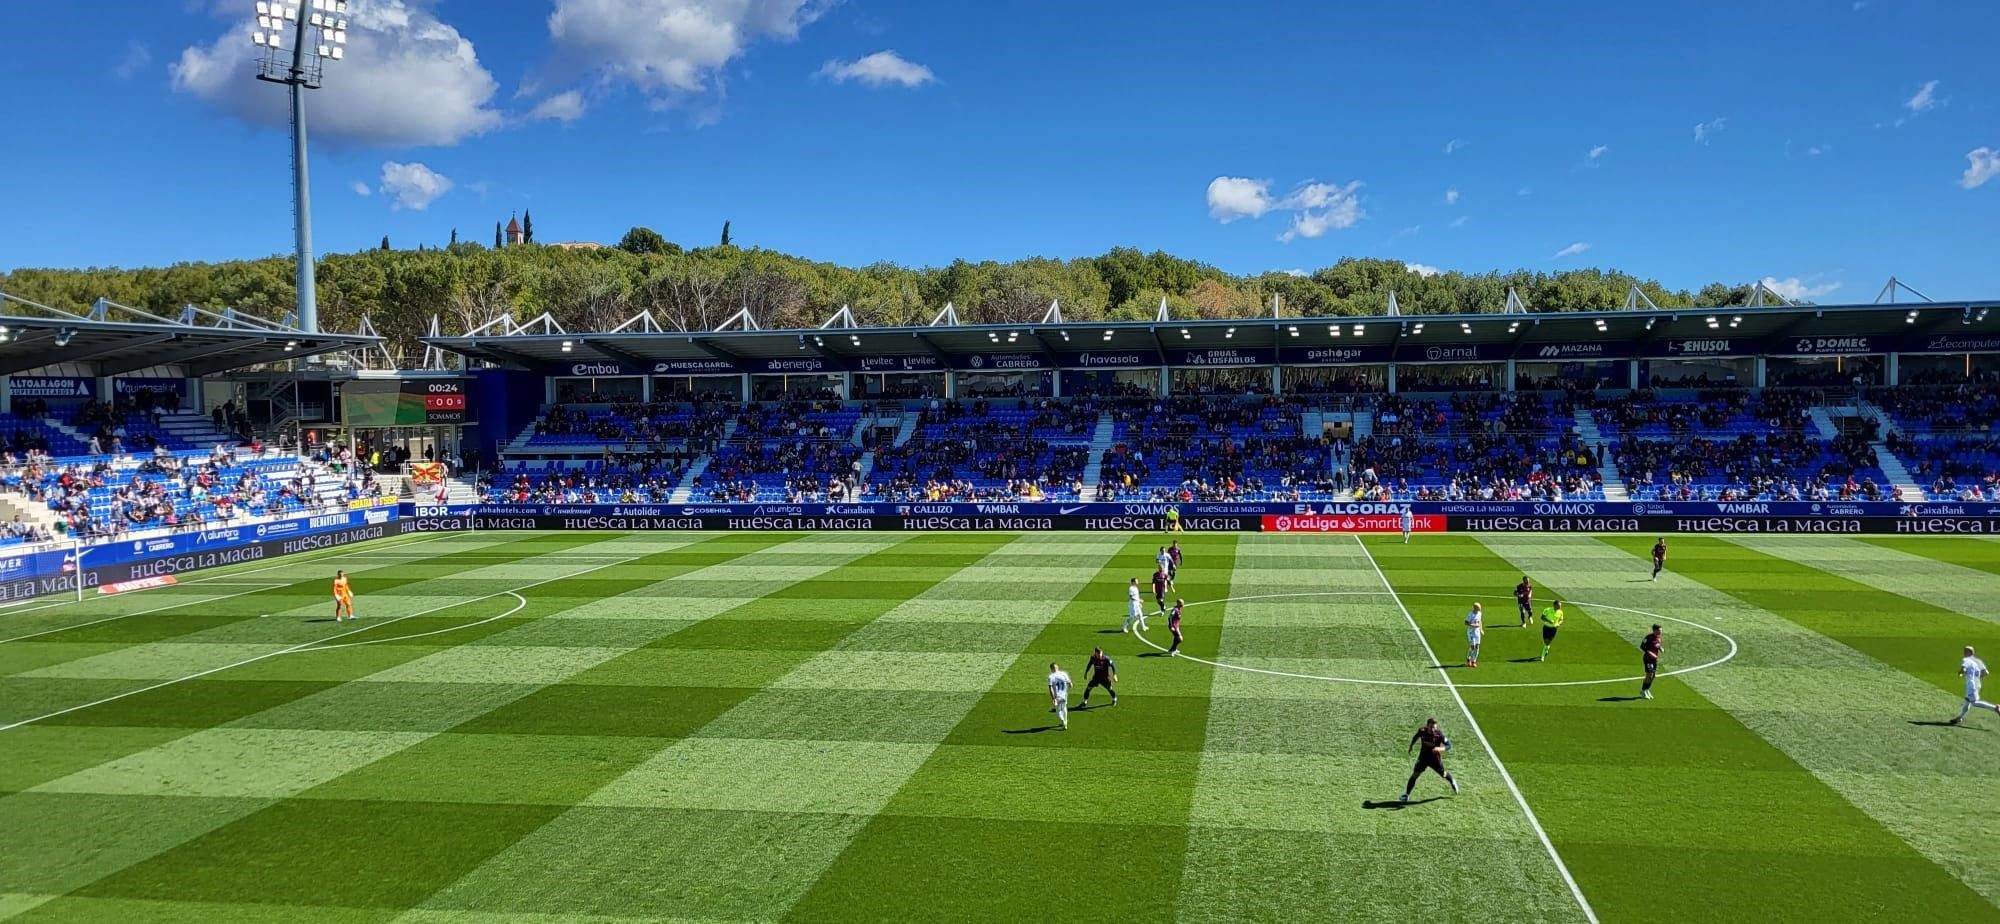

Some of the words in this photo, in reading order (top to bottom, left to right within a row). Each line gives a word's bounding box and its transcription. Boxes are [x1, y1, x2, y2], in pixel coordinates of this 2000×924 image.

[1561, 344, 1602, 352] MAZANA
[1816, 338, 1867, 348] DOMEC
[1308, 348, 1362, 359] gashogar
[1442, 346, 1477, 357] arnal
[996, 360, 1039, 368] CABRERO
[1089, 355, 1139, 364] navasola
[10, 380, 75, 388] ALTOARAGON
[428, 383, 458, 393] 00:24
[415, 506, 448, 517] IBOR
[478, 506, 537, 515] abbahotels.com
[623, 507, 661, 516] Autolider
[766, 505, 802, 514] alumbra
[836, 505, 875, 514] CaixaBank
[913, 505, 953, 514] CALLIZO
[984, 504, 1020, 514] AMBAR
[1124, 504, 1179, 515] SOMMOS
[1294, 503, 1317, 515] EL
[1322, 503, 1411, 515] ALCORAZ
[1533, 503, 1595, 515] SOMMOS
[1726, 503, 1770, 514] AMBAR
[1914, 505, 1965, 515] CaixaBank
[1293, 516, 1339, 531] LaLiga
